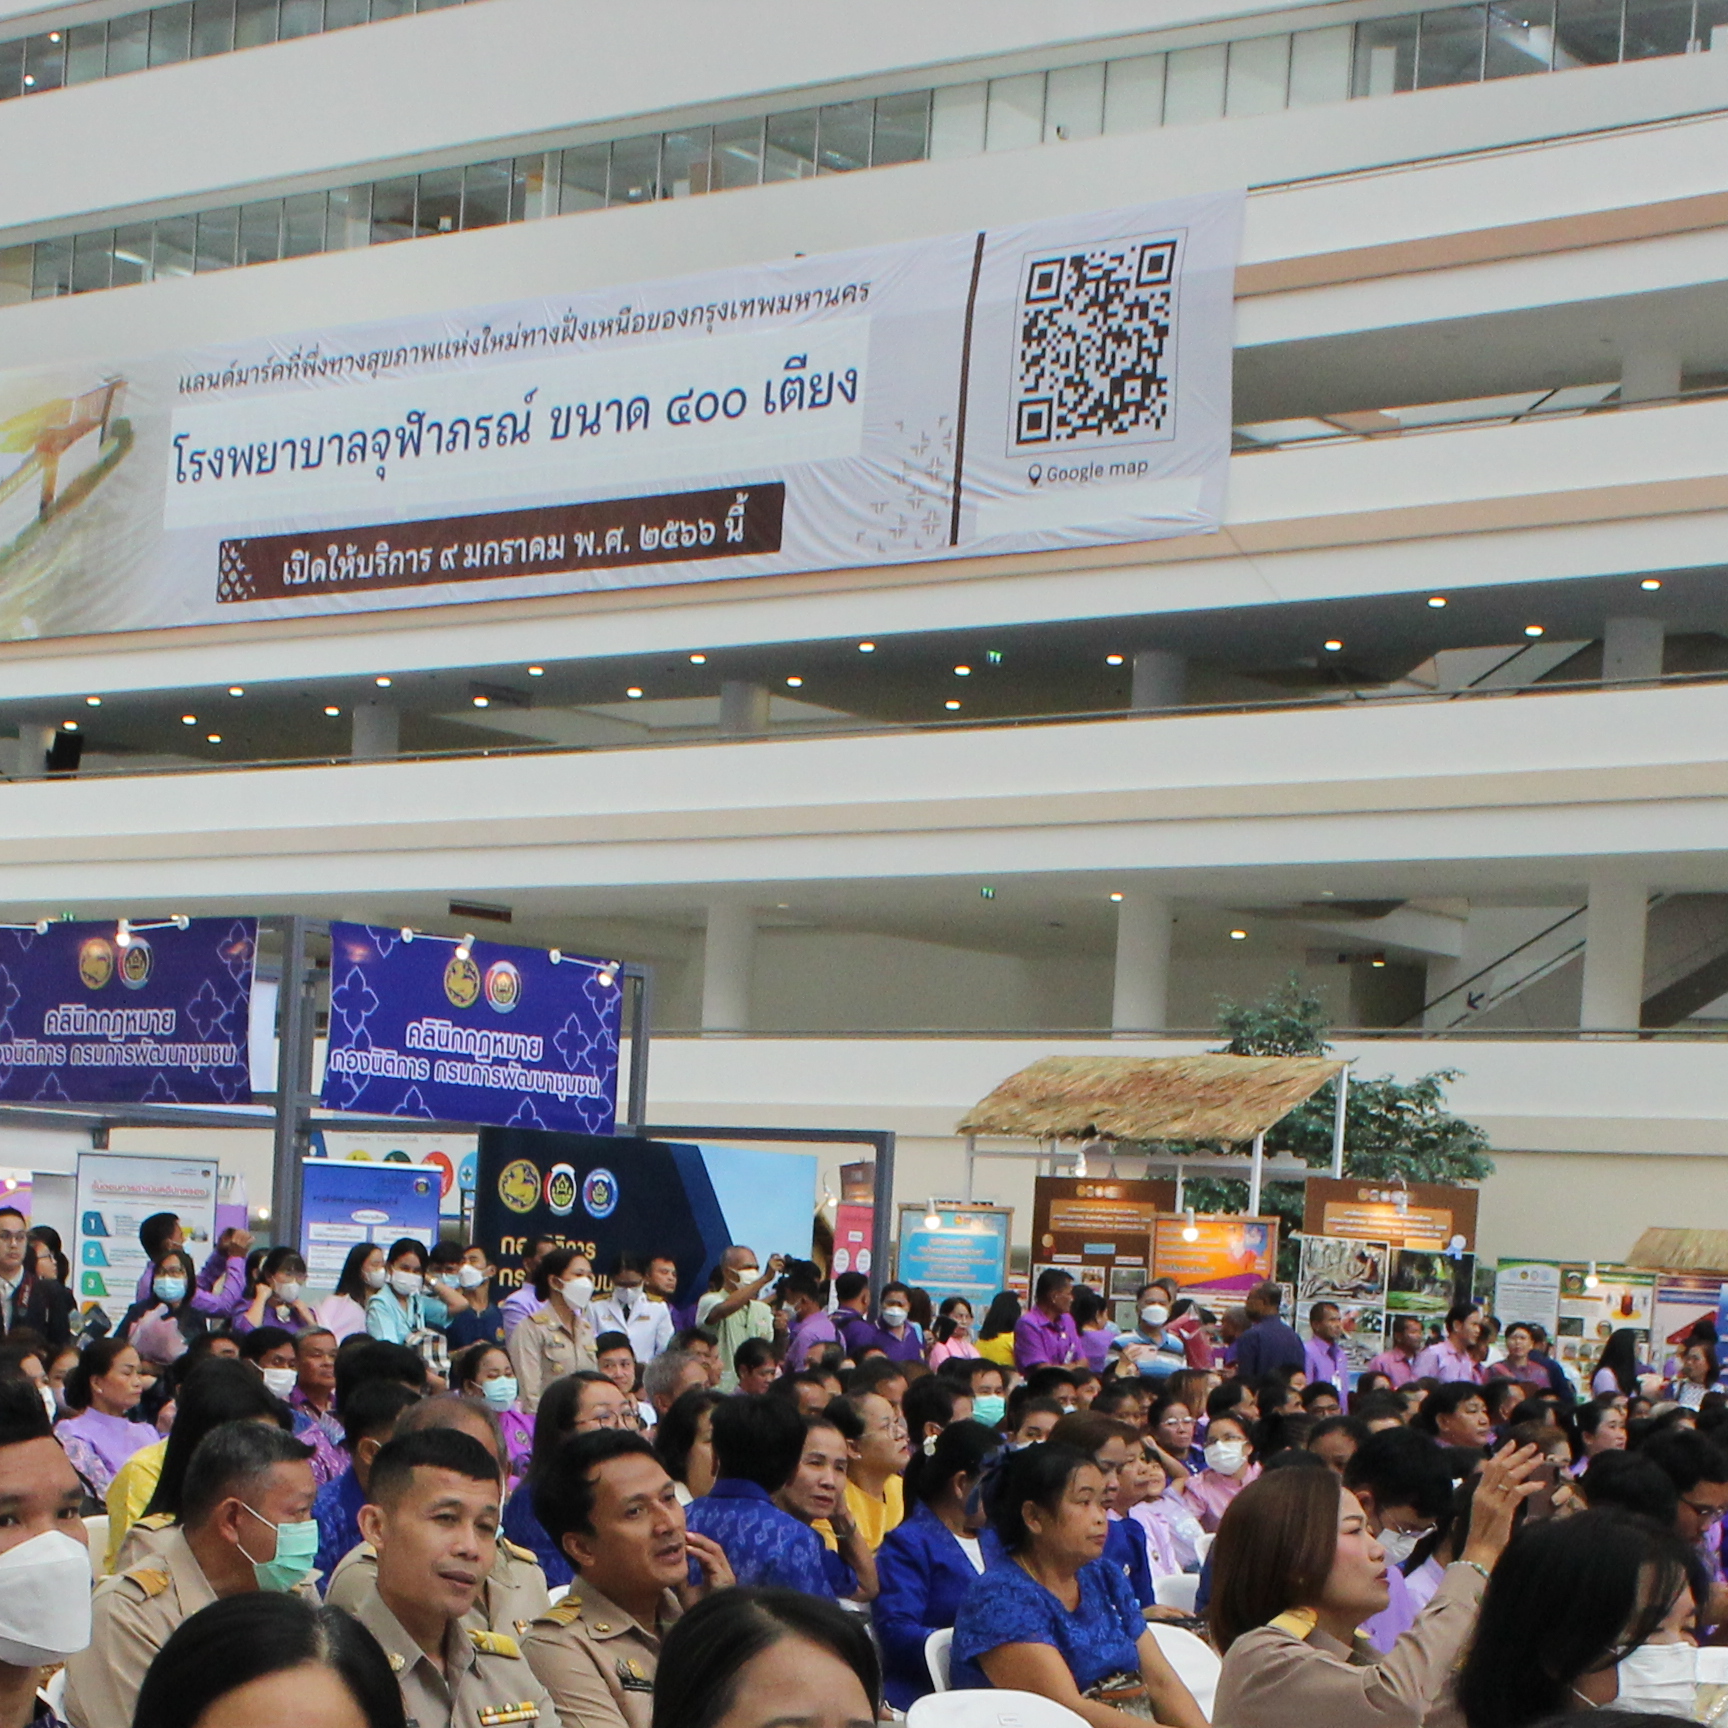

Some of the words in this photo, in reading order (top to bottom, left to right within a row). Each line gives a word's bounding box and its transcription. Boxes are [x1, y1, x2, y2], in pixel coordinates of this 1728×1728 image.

[173, 387, 539, 485] โรงพยาบาลจุฬาภรณ์
[550, 389, 651, 442] ขนาด
[666, 382, 748, 427] ๔๐๐
[763, 352, 859, 417] เตียง
[1046, 461, 1105, 487] Google
[1108, 458, 1149, 483] map
[281, 539, 434, 586] เปิดให้บริการ
[465, 530, 565, 571] มกราคม
[574, 524, 631, 560] พ.ศ.
[724, 492, 745, 544] นี้
[69, 1038, 238, 1074] กรมการพัฒนาชุมชน
[330, 1046, 431, 1081] กองนิติการ
[433, 1060, 602, 1103] กรมการพัฒนาชุมชน
[89, 1218, 96, 1230] 1
[88, 1247, 97, 1259] 2
[87, 1276, 96, 1288] 3
